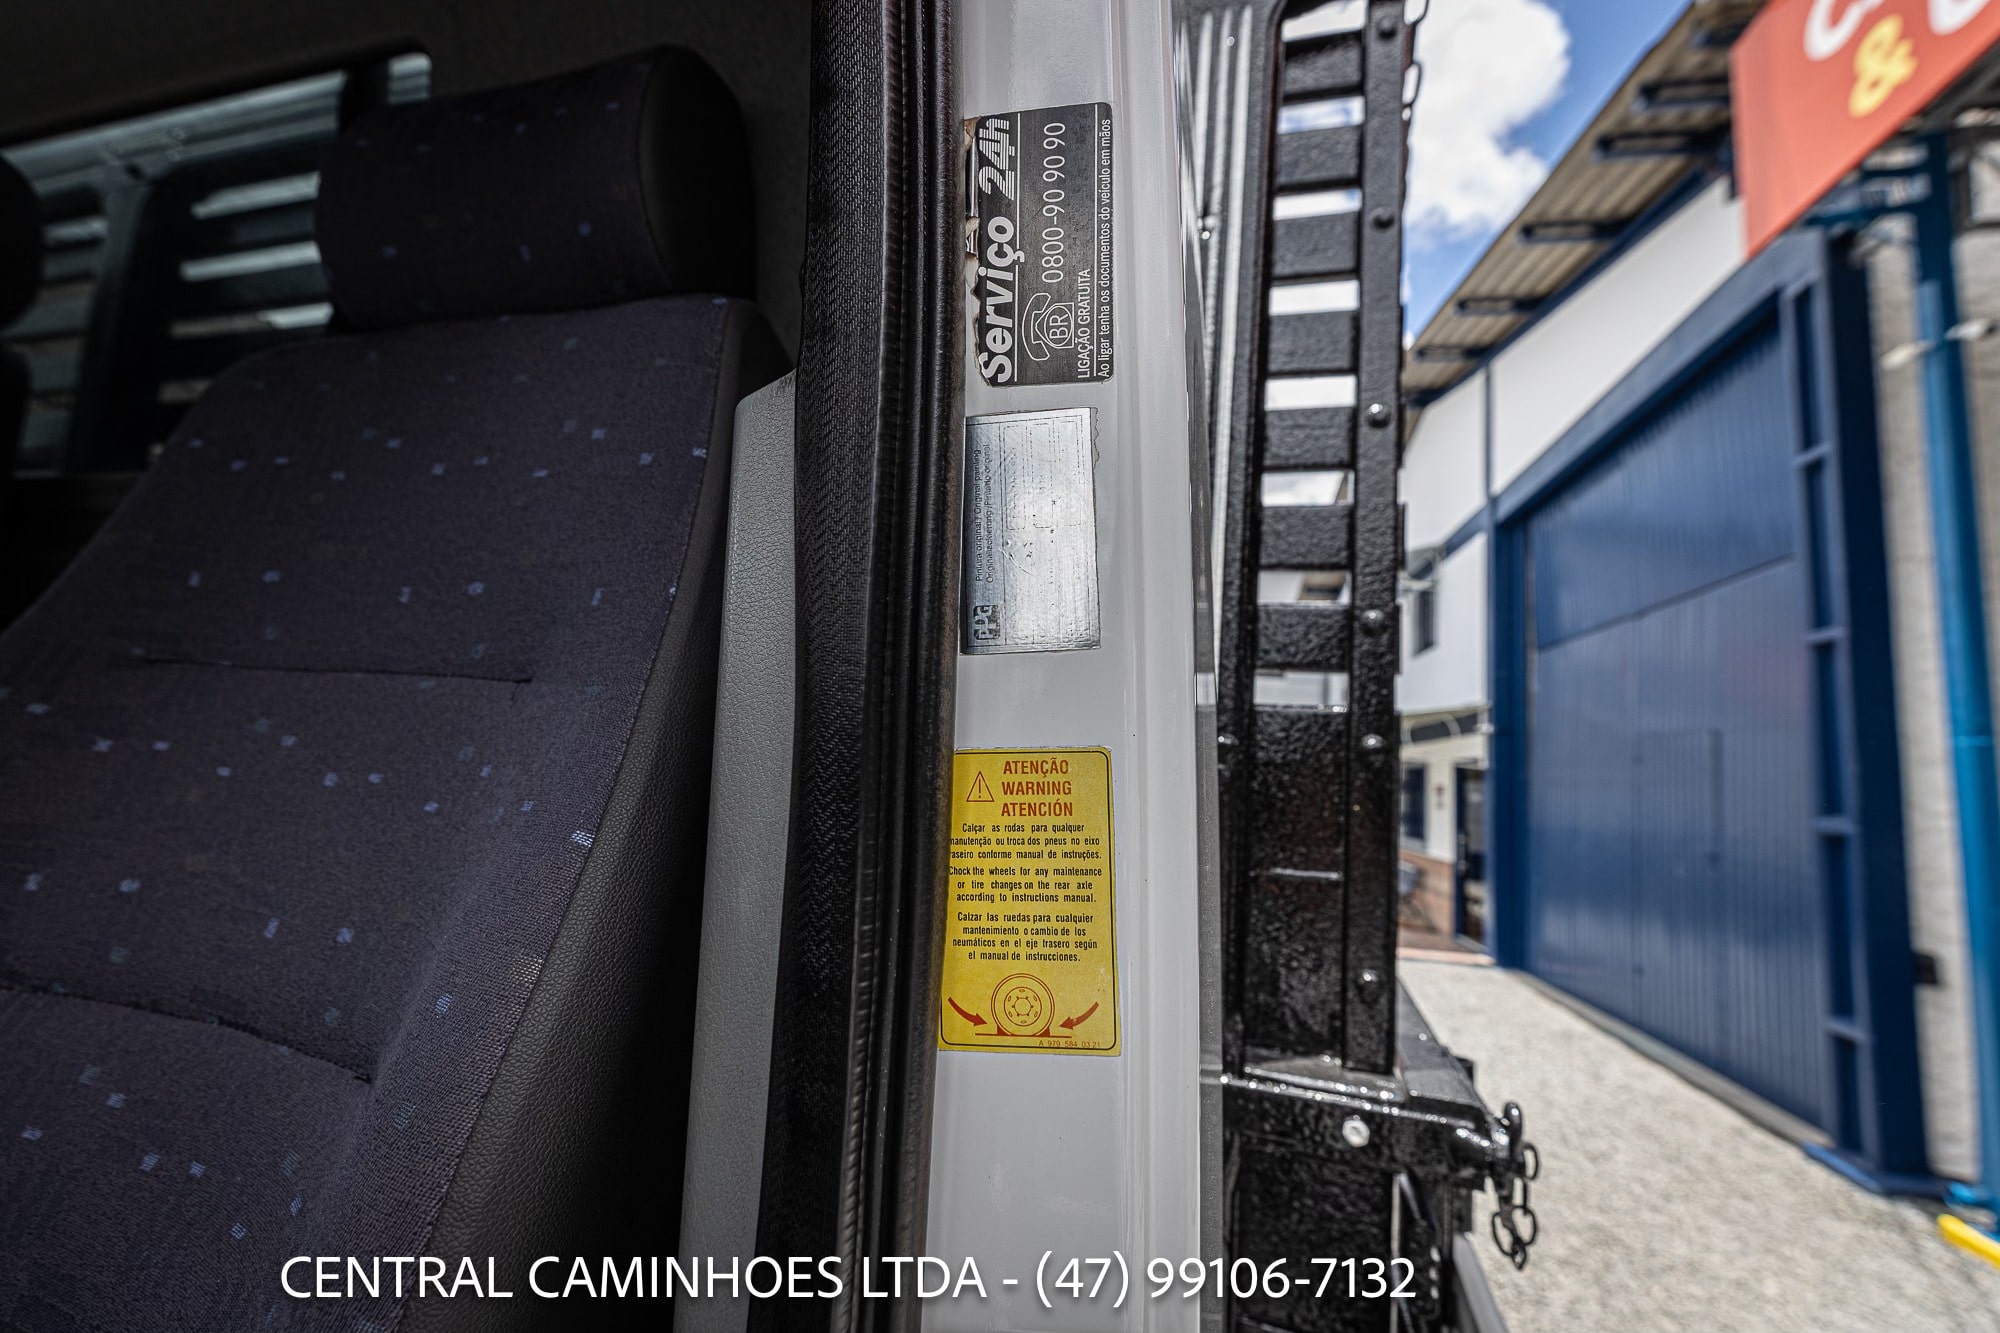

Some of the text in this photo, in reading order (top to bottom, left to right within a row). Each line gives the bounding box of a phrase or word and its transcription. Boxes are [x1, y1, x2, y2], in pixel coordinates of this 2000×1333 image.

[1041, 122, 1066, 283] 0800-90 90 90
[978, 118, 1025, 383] Serviço 24h
[1098, 119, 1112, 377] Ao ligar tenha os documentos do veículo em mãos
[1049, 314, 1068, 339] BR
[1075, 268, 1094, 378] LIGAÇÃO GRATUITA
[972, 483, 982, 515] Original
[1003, 758, 1069, 778] ATENÇÃO
[1001, 781, 1072, 796] WARNING
[1001, 799, 1073, 817] ATENCIÓN
[962, 823, 985, 834] Calçar
[1004, 824, 1025, 832] rodas
[1031, 825, 1047, 835] para
[1052, 824, 1085, 834] qualquer
[1006, 837, 1025, 845] troca
[1028, 837, 1040, 845] dos
[1045, 838, 1067, 847] pneus
[1084, 837, 1100, 845] eixo
[978, 850, 1012, 858] conforme
[1016, 850, 1044, 858] manual
[1048, 850, 1057, 858] de
[1062, 850, 1102, 861] instruções.
[973, 867, 984, 875] the
[989, 867, 1016, 876] wheels
[1020, 867, 1030, 876] for
[1035, 868, 1048, 878] any
[1053, 867, 1102, 876] maintenance
[957, 881, 965, 889] or
[971, 880, 984, 889] tire
[991, 880, 1022, 891] changes
[1038, 880, 1050, 889] the
[1077, 880, 1092, 889] axle
[956, 893, 1096, 903] according to instructions manual.
[958, 912, 1093, 924] Calzar las ruedas para cualquier
[963, 926, 1086, 936] mantenimiento o cambio de los
[952, 937, 1097, 950] neumáticos en el eje trasero según
[968, 951, 1081, 962] el manual de instrucciones.
